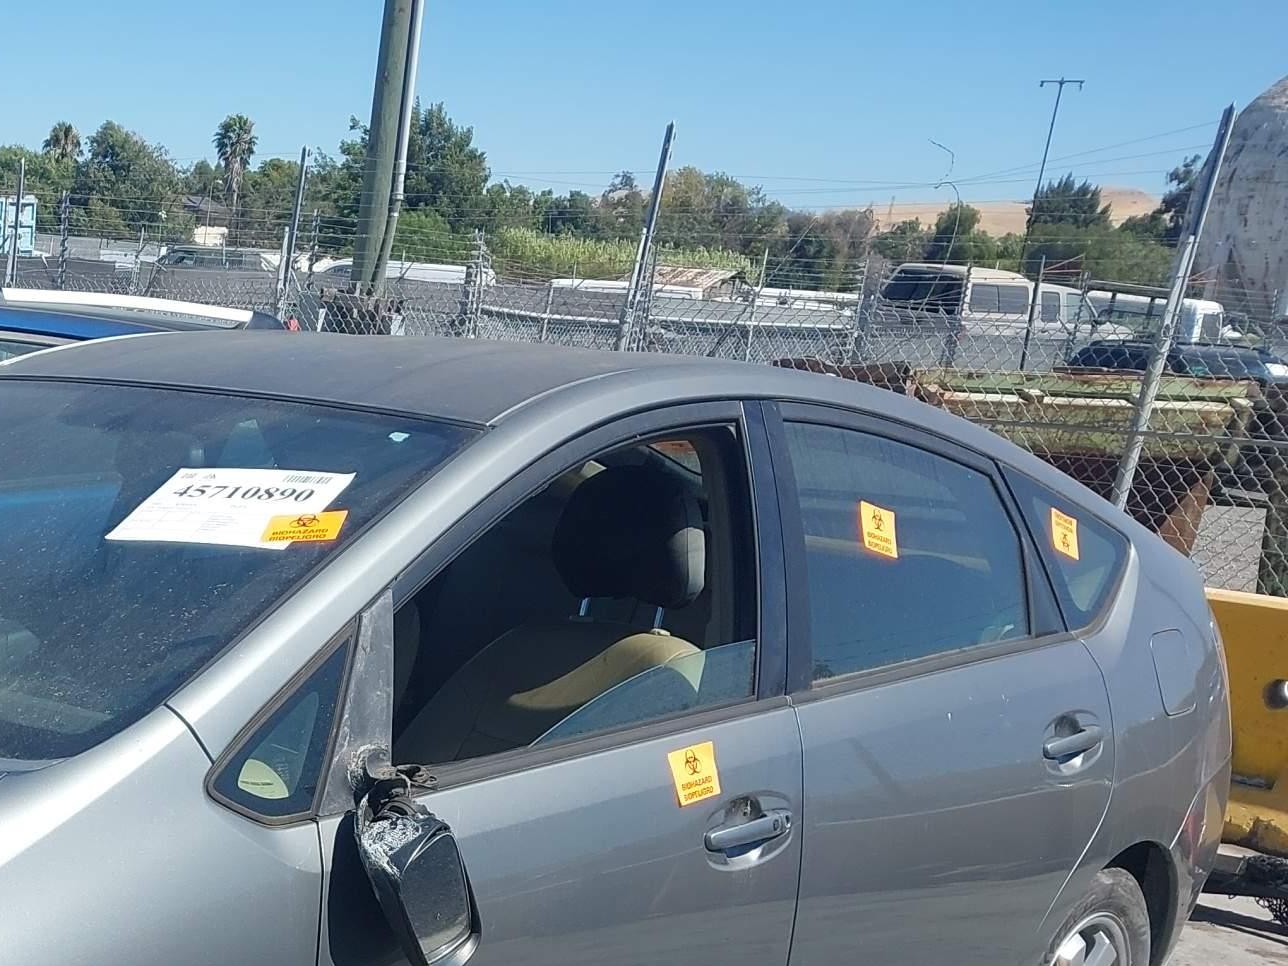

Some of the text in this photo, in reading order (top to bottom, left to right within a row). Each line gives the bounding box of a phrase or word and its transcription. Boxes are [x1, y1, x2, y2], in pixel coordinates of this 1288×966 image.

[173, 483, 316, 504] 45710890
[268, 534, 328, 542] BIOPELIGRO
[271, 528, 329, 536] BIOHAZARD
[681, 775, 713, 792] BIOHAZARD
